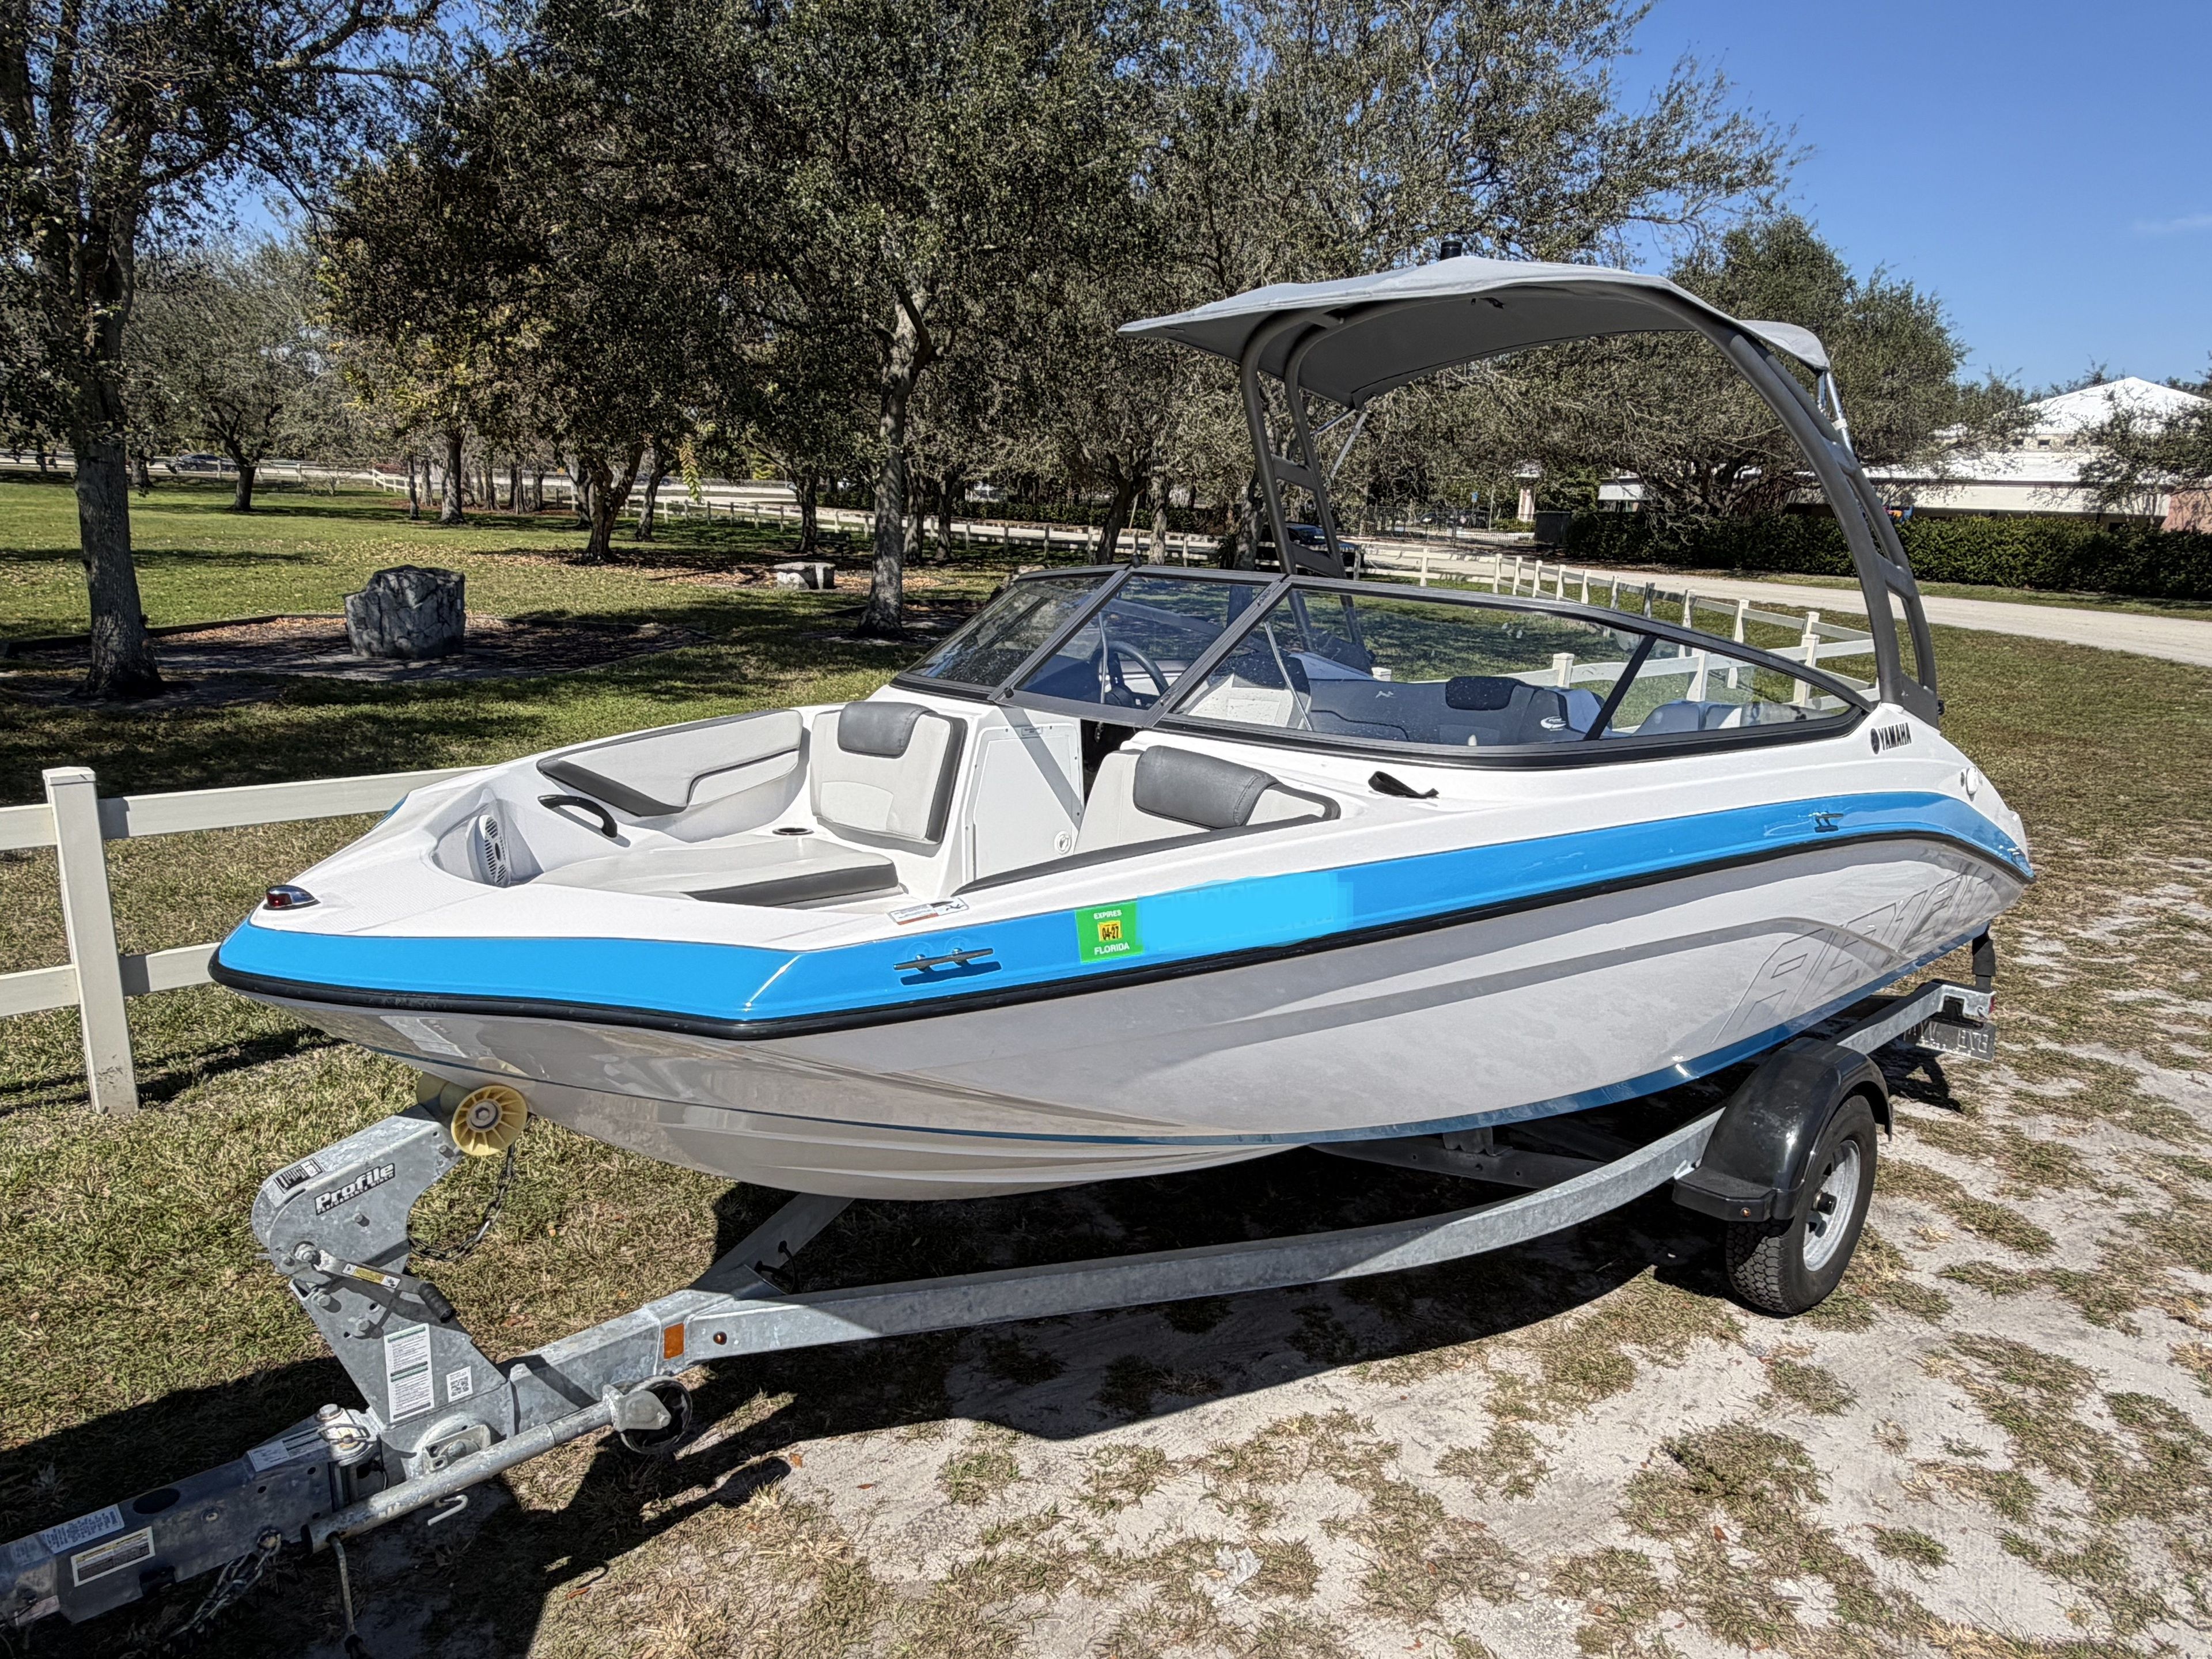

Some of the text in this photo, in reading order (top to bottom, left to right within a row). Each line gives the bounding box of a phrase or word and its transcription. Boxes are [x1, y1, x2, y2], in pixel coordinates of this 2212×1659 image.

[1878, 722, 1911, 751] YAMAHA
[1094, 910, 1122, 919] EXPIRES
[1094, 942, 1130, 955] FLORIDA
[315, 1163, 394, 1210] Profile
